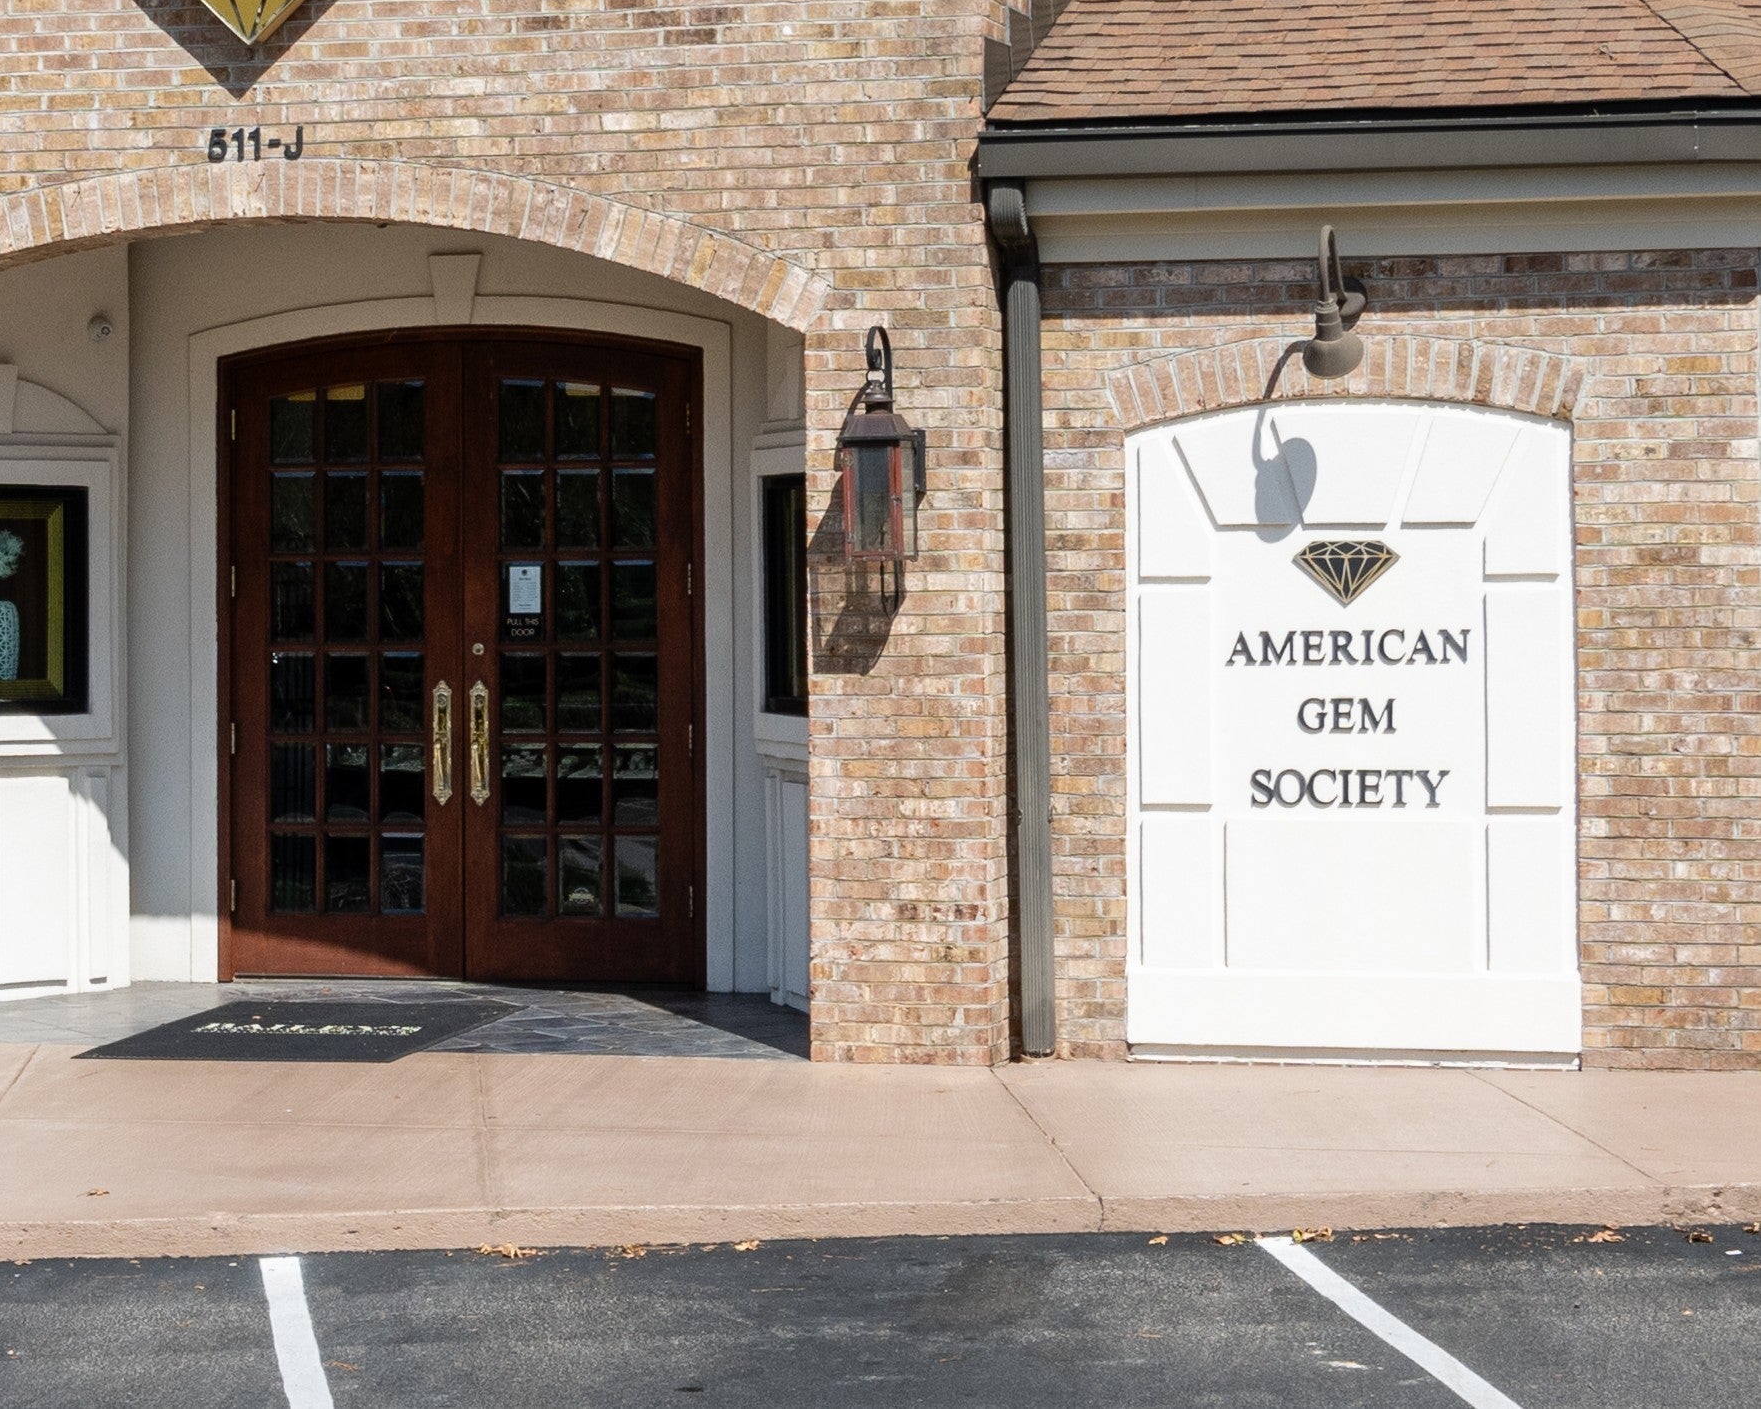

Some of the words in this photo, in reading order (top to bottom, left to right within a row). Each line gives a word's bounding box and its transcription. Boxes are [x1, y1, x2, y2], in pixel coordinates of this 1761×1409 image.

[207, 125, 304, 163] 511-J
[507, 618, 523, 626] PULL
[511, 628, 535, 637] DOOR
[1225, 629, 1471, 666] AMERICAN
[1297, 697, 1397, 734] GEM
[1250, 769, 1451, 809] SOCIETY
